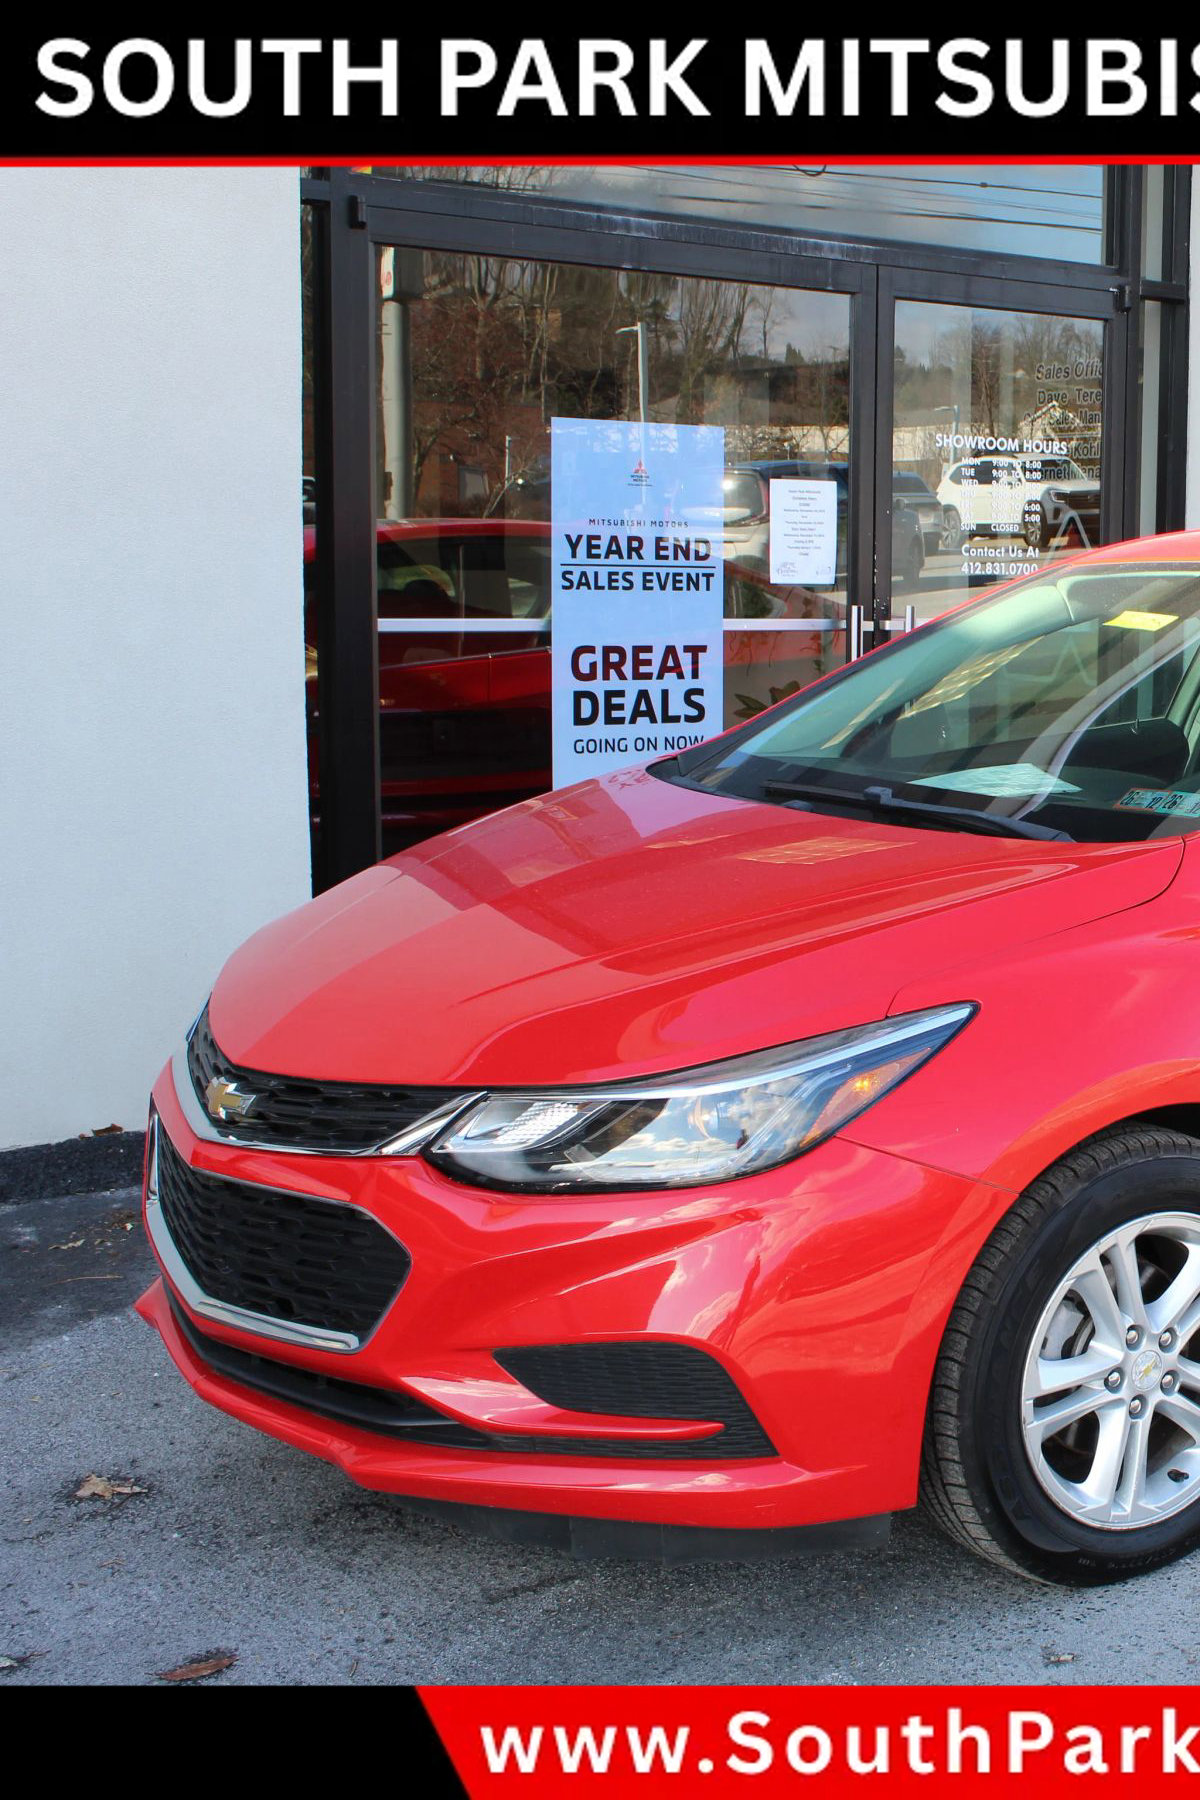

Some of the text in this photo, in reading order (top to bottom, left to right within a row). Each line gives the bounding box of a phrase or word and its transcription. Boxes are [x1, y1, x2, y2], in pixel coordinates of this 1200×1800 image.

[1036, 364, 1070, 381] Sales
[1038, 390, 1068, 405] Dave
[935, 433, 1019, 452] SHOWROOM
[1023, 439, 1067, 455] HOURS
[961, 457, 1041, 469] MON 9:00 TO 8:00
[961, 468, 1041, 479] TUE 9:00 TO 8:00
[1024, 503, 1040, 511] 6:00
[589, 519, 646, 527] MITSUBISHI
[1024, 514, 1040, 522] 5:00
[961, 522, 1019, 532] SUN CLOSED
[564, 534, 712, 561] YEAR END
[961, 544, 1040, 558] Contact Us At
[961, 561, 1038, 575] 412.831.0700
[561, 570, 715, 592] SALES EVENT
[571, 644, 707, 682] GREAT
[573, 687, 706, 727] DEALS
[573, 735, 704, 754] GOING ON NOW
